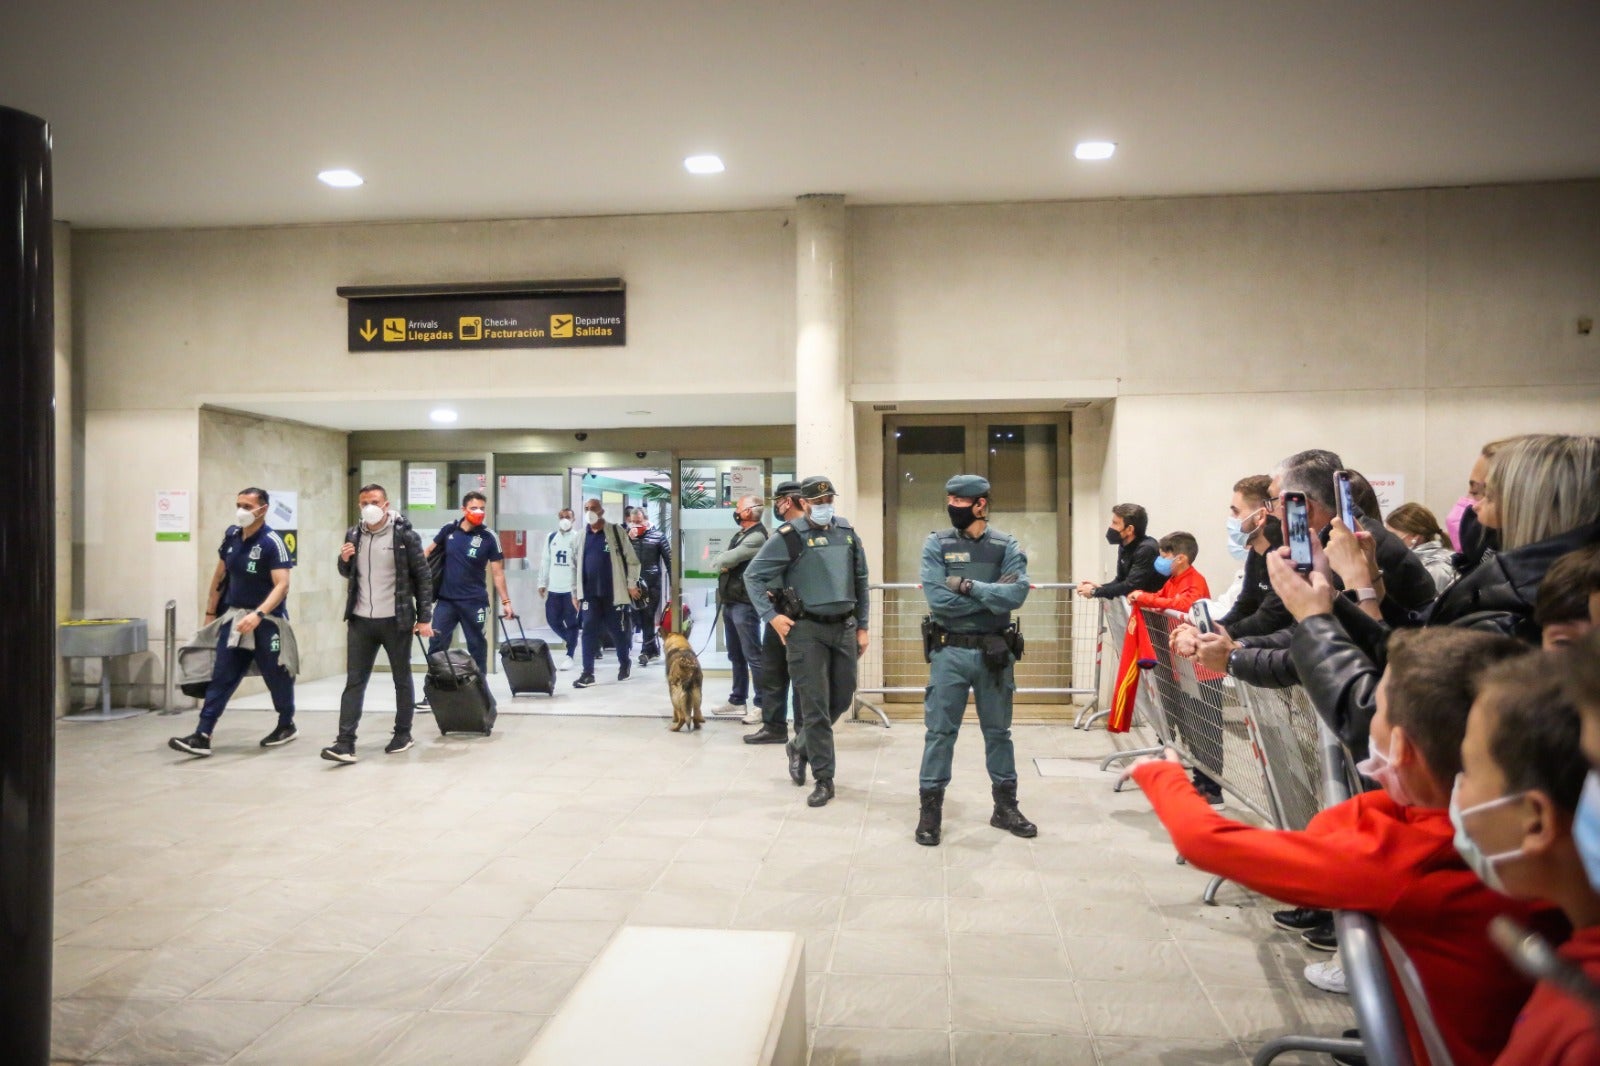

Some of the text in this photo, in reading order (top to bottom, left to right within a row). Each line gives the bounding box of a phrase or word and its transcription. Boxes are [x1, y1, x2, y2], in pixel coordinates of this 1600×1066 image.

[408, 320, 438, 329] Arrivals
[484, 318, 518, 327] Check-in
[575, 316, 621, 327] Departures
[408, 330, 454, 342] Llegadas
[484, 328, 545, 339] Facturación
[575, 326, 613, 337] Salidas
